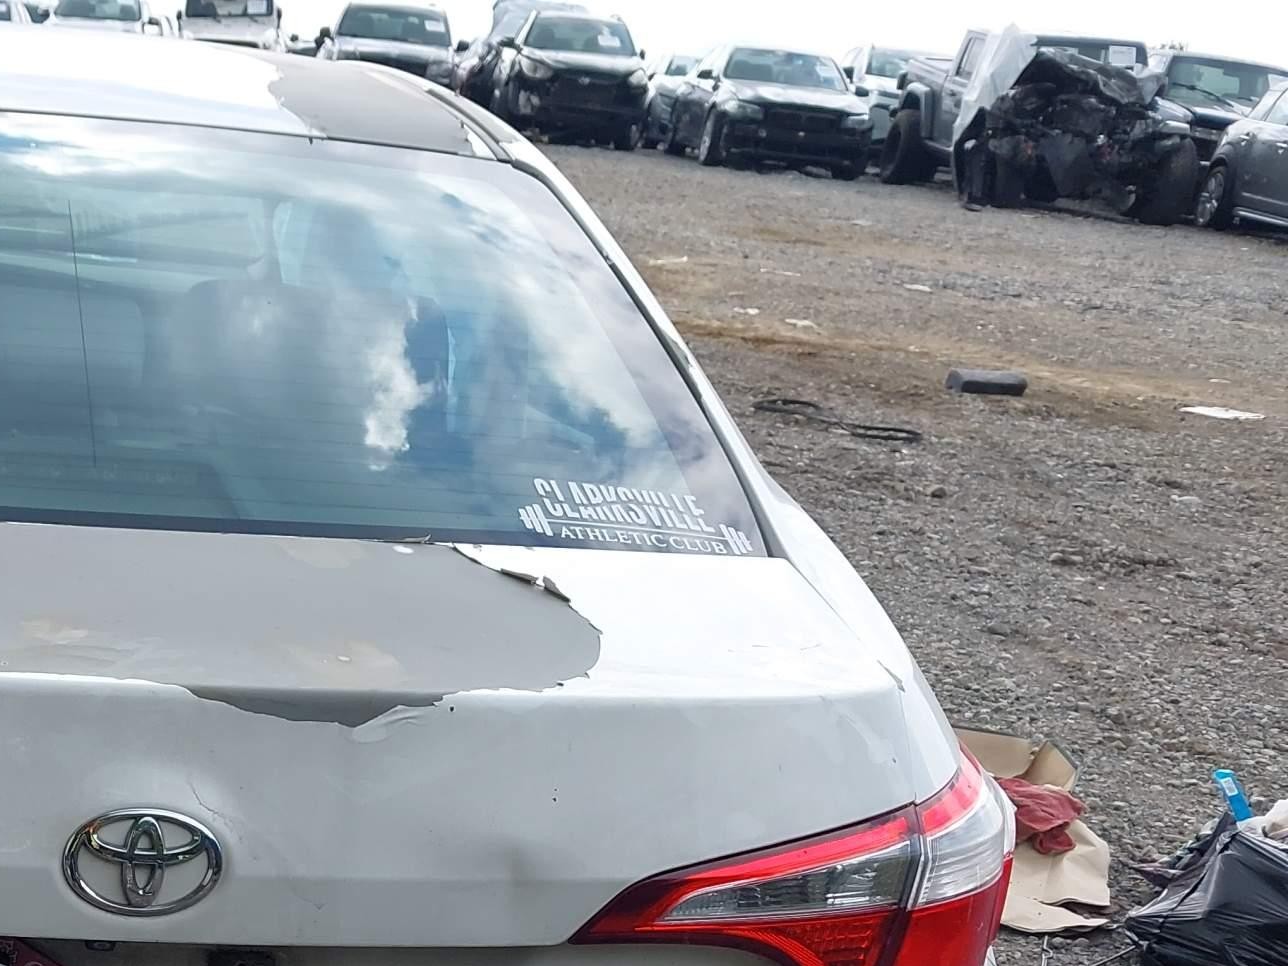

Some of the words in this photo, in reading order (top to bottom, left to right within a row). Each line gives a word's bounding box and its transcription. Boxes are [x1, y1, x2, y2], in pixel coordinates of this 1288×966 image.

[533, 478, 716, 532] CLARKSVILLE
[561, 526, 667, 547] ATHLETIC
[669, 535, 727, 554] CLUB
